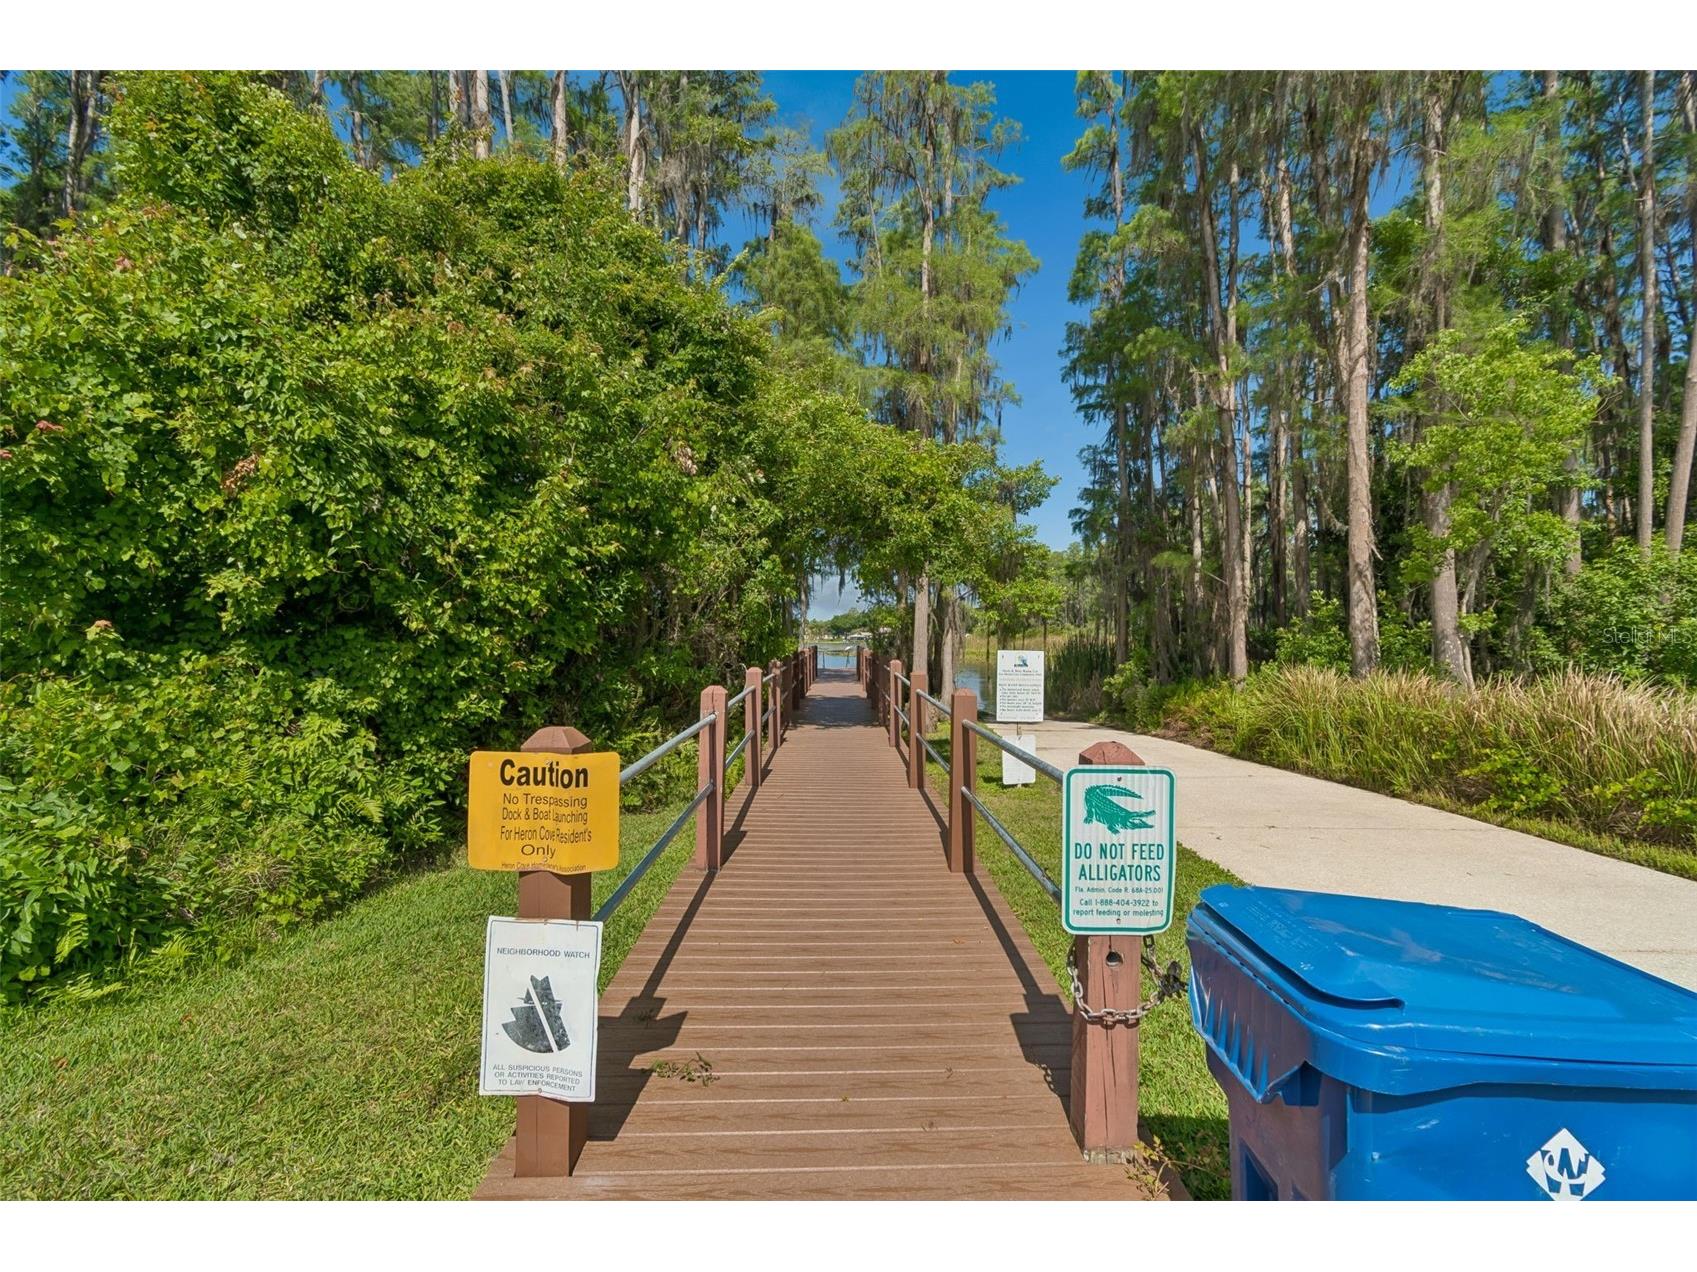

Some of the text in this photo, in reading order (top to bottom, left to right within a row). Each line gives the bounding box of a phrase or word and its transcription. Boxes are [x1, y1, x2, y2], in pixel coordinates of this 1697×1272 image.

[500, 758, 589, 789] Caution
[503, 793, 588, 809] No Trespassing
[502, 807, 588, 825] Dock & Boat Launching
[500, 826, 592, 844] For Heron Cove Resident's
[521, 844, 557, 859] Only
[1074, 843, 1164, 860] DO NOT FEED
[1078, 864, 1161, 881] ALLIGATORS
[1079, 898, 1092, 906] Call
[1095, 898, 1150, 906] 1-888-404-3922
[1073, 909, 1094, 917] report
[1096, 909, 1121, 917] feeding
[1132, 909, 1164, 917] molesting
[497, 947, 590, 959] NEIGHBORHOOD WATCH
[507, 1071, 544, 1079] ACTIVITIES
[546, 1073, 580, 1085] REPORTED
[508, 1064, 550, 1073] SUSPICIOUS
[552, 1066, 583, 1078] PERSONS
[527, 1079, 576, 1092] ENFORCEMENT
